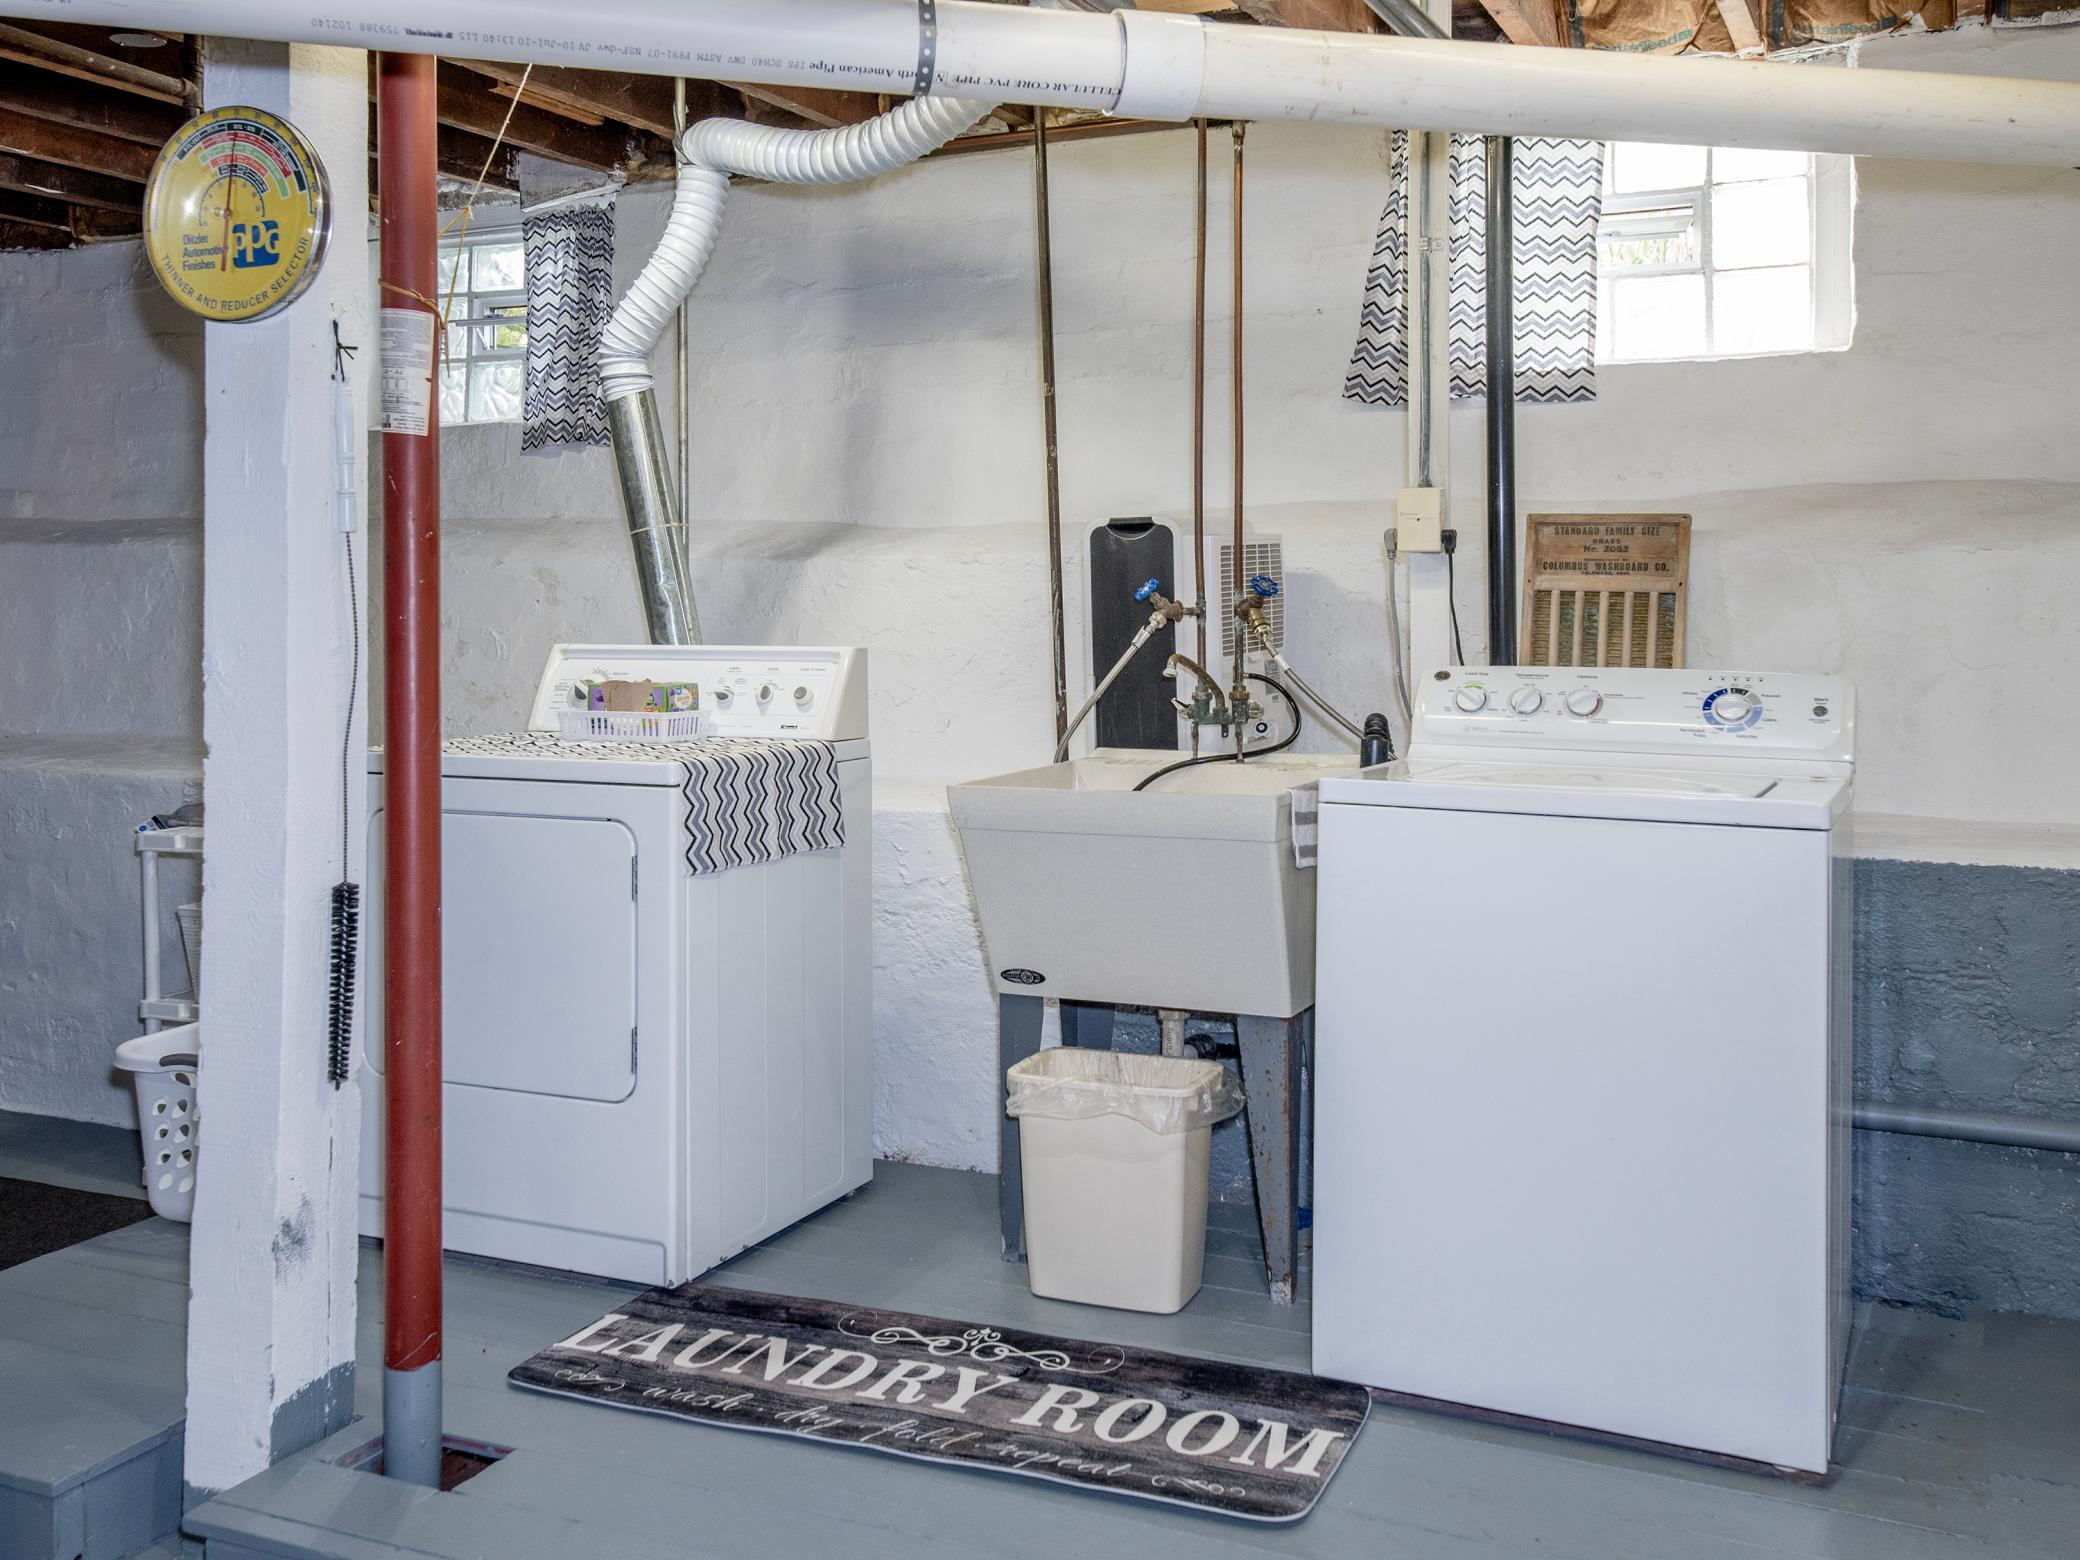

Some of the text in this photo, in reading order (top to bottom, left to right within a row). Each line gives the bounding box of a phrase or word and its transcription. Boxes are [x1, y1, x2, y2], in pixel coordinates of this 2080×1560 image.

[311, 17, 351, 31] 102140
[360, 23, 400, 35] 759388
[483, 34, 514, 44] 13:40
[518, 38, 575, 50] 10-Jul-10
[597, 44, 642, 56] NSF-dwv
[648, 48, 691, 60] F891-07
[696, 52, 722, 63] ASTM
[727, 54, 745, 65] DWV
[751, 57, 782, 68] SCH40
[788, 59, 805, 70] IPS
[809, 59, 835, 74] Pipe
[839, 62, 895, 78] American
[955, 74, 981, 86] PIPE
[984, 76, 1009, 87] PVC
[1015, 79, 1050, 91] CORE
[1053, 82, 1121, 97] CELLULAR
[183, 260, 216, 271] Finishes
[162, 237, 309, 311] THINNER AND REDUCER SELECTOR
[1554, 526, 1661, 536] STANDARD FAMILY SIZE
[1542, 561, 1670, 572] COLUMBUS WASHBOARD CO.
[553, 1313, 1345, 1477] LAUNDRY ROOM
[643, 1388, 1131, 1476] wash dry fold repeat
